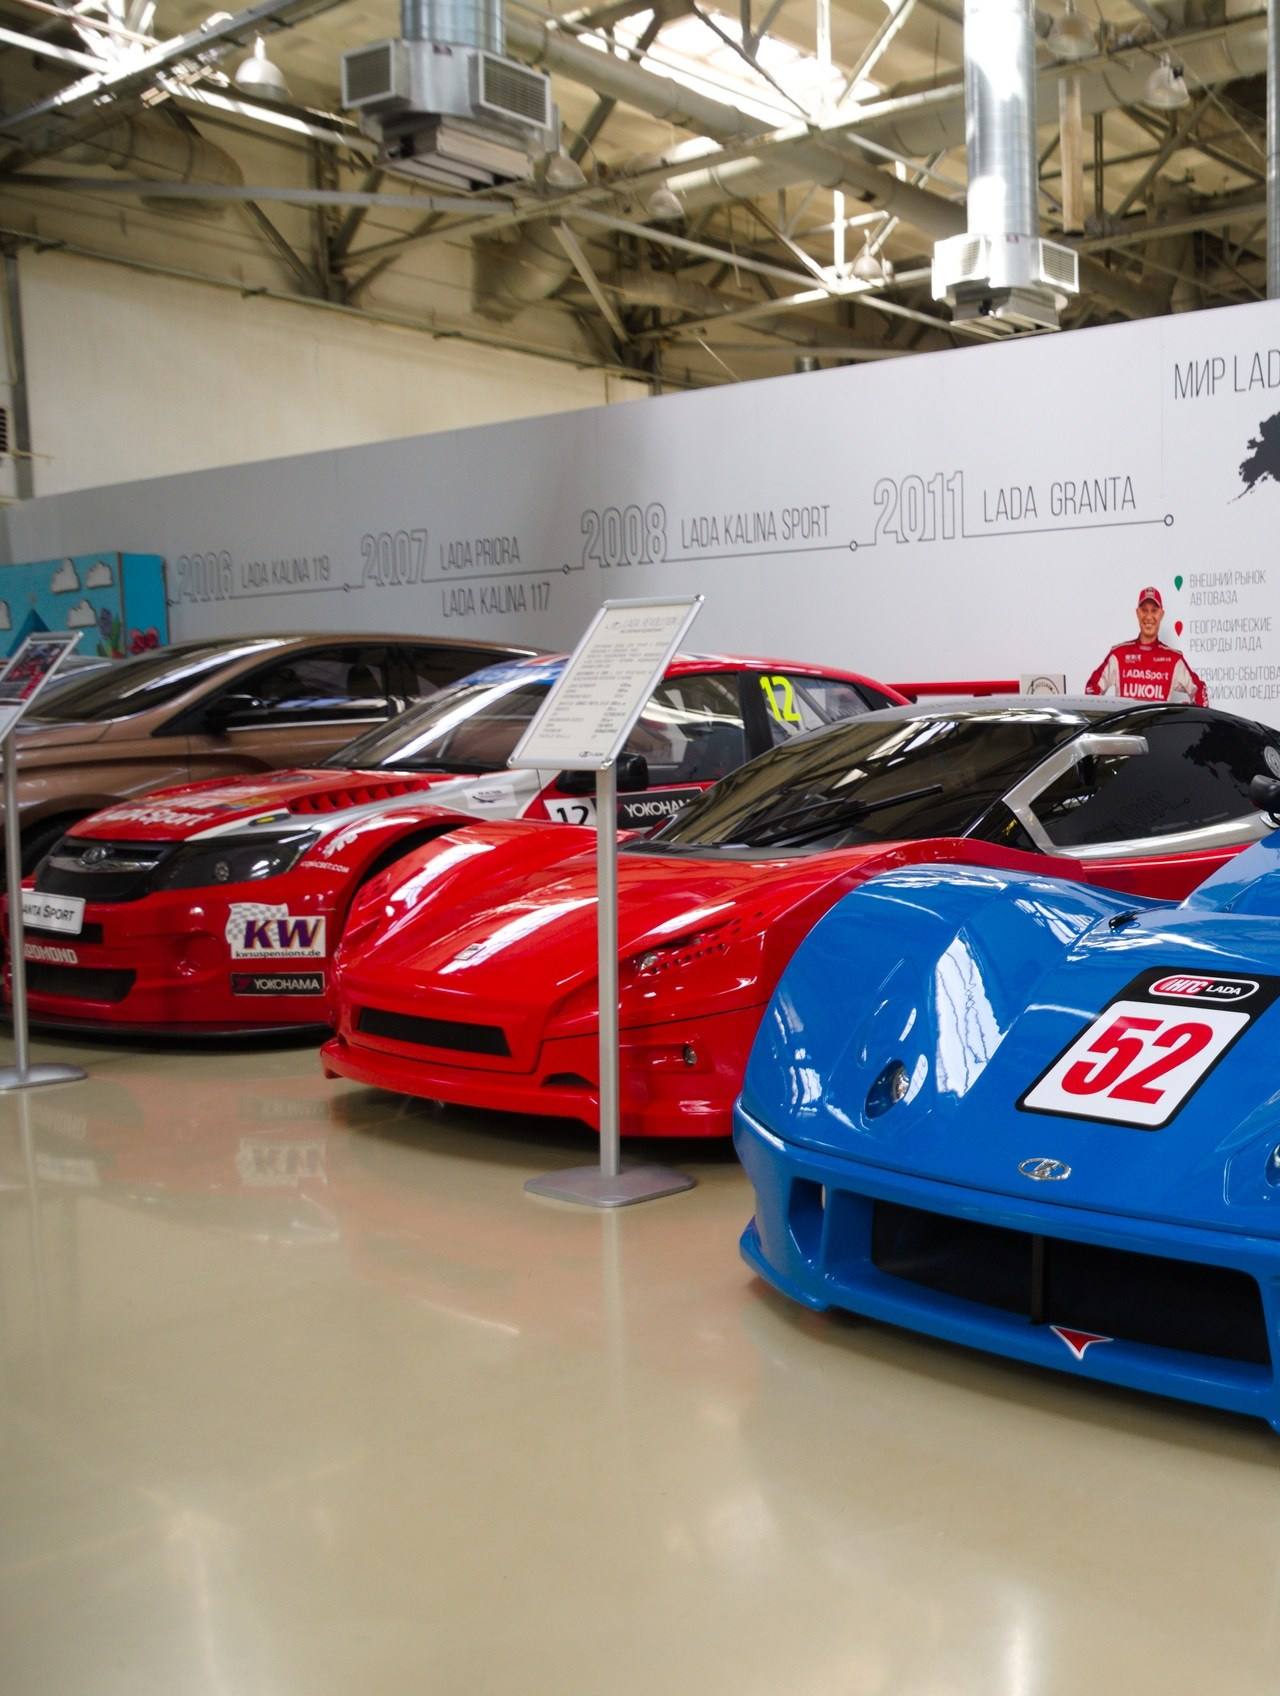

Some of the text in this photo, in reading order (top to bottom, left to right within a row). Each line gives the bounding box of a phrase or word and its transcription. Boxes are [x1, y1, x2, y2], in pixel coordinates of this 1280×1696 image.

[1174, 357, 1225, 400] МИР
[873, 471, 1136, 544] 2011 LADA GRANTA
[581, 502, 830, 566] 2008 LADA KALINA SPORT
[361, 529, 520, 586] 2007 LADA PRIORA
[177, 551, 233, 602] 2006
[241, 563, 268, 589] LADA
[271, 559, 309, 585] KALINA
[1190, 569, 1266, 588] ВНЕШНИЙ РЫНОК
[442, 582, 551, 617] LADA KALINA 117
[1190, 590, 1238, 606] АВТОВАЗА
[1190, 617, 1272, 634] ГЕОГРАФИЧЕСКИЕ
[1189, 636, 1262, 653] РЕКОРДЫ ЛАДА
[759, 675, 801, 722] 12
[1123, 683, 1165, 699] LUKOIL
[624, 799, 690, 818] YOKOHA
[243, 919, 323, 949] KW
[235, 950, 321, 959] kwsuspensions.de
[254, 979, 320, 990] YOKOHAMA
[1206, 985, 1242, 995] LADA
[1061, 1015, 1213, 1104] 52
